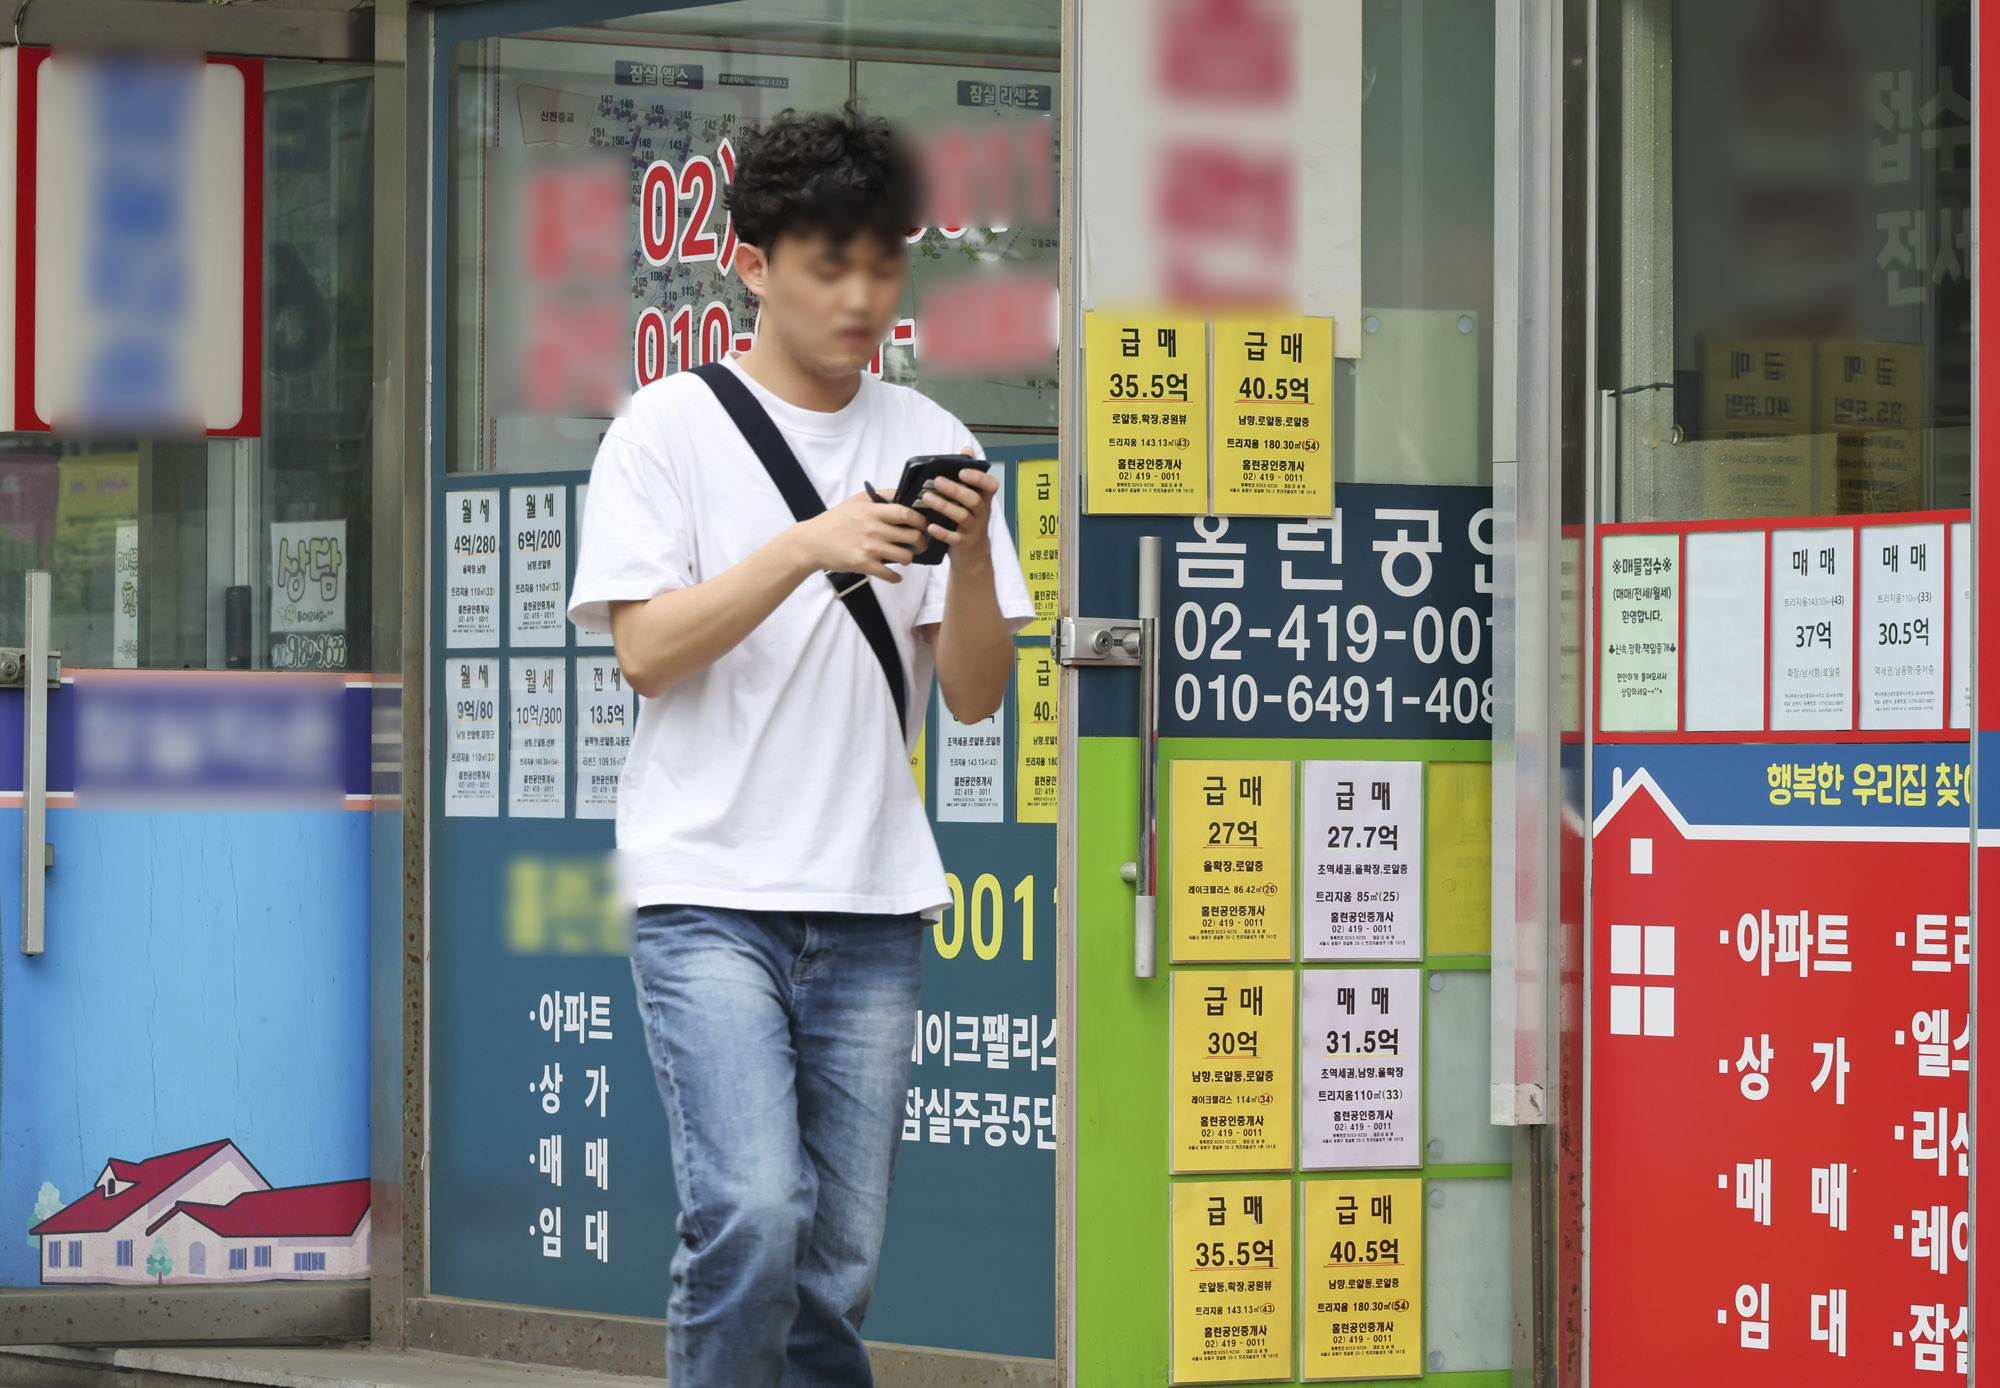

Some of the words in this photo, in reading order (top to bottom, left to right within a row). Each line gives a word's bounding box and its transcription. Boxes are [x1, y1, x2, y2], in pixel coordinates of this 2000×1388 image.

[630, 65, 658, 85] 잠실
[662, 66, 689, 86] 엘스
[970, 85, 996, 105] 잠실
[1000, 86, 1039, 106] 리센츠
[652, 105, 665, 115] 145
[724, 114, 736, 124] 141
[704, 121, 717, 130] 142
[639, 138, 651, 148] 148
[641, 151, 654, 161] 149
[635, 278, 648, 287] 105
[650, 271, 663, 281] 108
[664, 292, 677, 301] 110
[1121, 328, 1141, 357] 급
[1158, 329, 1177, 358] 매
[1245, 332, 1267, 361] 급
[1281, 333, 1302, 363] 매
[1110, 373, 1188, 401] 35.5억
[1239, 376, 1309, 403] 40.5억
[1109, 437, 1137, 448] 트리지움
[1227, 438, 1260, 449] 트리지움
[1118, 459, 1182, 470] 홈런공인중개사
[1242, 459, 1305, 472] 홈런공인중개사
[1036, 473, 1051, 500] 급
[462, 499, 472, 523] 월
[480, 499, 490, 523] 세
[526, 494, 536, 519] 월
[544, 493, 554, 517] 세
[454, 534, 496, 556] 4억/280
[518, 529, 561, 552] 6억/200
[278, 536, 342, 603] 상담
[1792, 548, 1809, 577] 매
[1820, 547, 1835, 576] 매
[1882, 544, 1898, 573] 매
[1910, 543, 1926, 572] 매
[1621, 609, 1663, 624] 환영합니다.
[1174, 601, 1493, 664] 02-419-00
[1795, 620, 1832, 650] 37억
[1878, 617, 1929, 646] 30.5억
[460, 664, 471, 689] 월
[478, 664, 489, 689] 세
[525, 669, 536, 694] 월
[543, 669, 554, 694] 세
[593, 667, 603, 692] 전
[1036, 660, 1051, 687] 급
[457, 699, 493, 721] 9억/80
[516, 704, 563, 726] 10억/300
[590, 704, 625, 726] 13.5억
[1203, 776, 1227, 806] 급
[1240, 776, 1262, 806] 매
[1336, 782, 1355, 811] 급
[1371, 782, 1390, 811] 매
[1767, 762, 1844, 806] 행복한
[1852, 763, 1927, 806] 우리집
[1208, 821, 1258, 847] 27억
[1327, 825, 1398, 850] 27.7억
[1316, 891, 1352, 903] 트리지움
[1201, 905, 1265, 917] 홈런공인중개사
[1331, 911, 1394, 923] 홈런공인중개사
[1204, 986, 1227, 1016] 급
[1240, 986, 1263, 1016] 매
[1337, 987, 1355, 1015] 매
[1371, 987, 1389, 1015] 매
[1208, 1031, 1258, 1057] 30억
[1326, 1028, 1399, 1055] 31.5억
[1810, 1037, 1850, 1105] 가
[584, 1065, 609, 1118] 가
[1200, 1115, 1264, 1127] 홈런공인중개사
[1333, 1110, 1394, 1122] 홈런공인중개사
[585, 1138, 608, 1191] 매
[1335, 1196, 1358, 1225] 급
[1371, 1195, 1392, 1225] 매
[1811, 1163, 1848, 1232] 매
[1207, 1197, 1227, 1226] 급
[1243, 1196, 1263, 1225] 매
[585, 1210, 608, 1263] 대
[1195, 1239, 1274, 1267] 35.5억
[1330, 1238, 1399, 1264] 40.5억
[1195, 1305, 1224, 1316] 트리지움
[1317, 1302, 1349, 1313] 트리지움
[1204, 1325, 1268, 1338] 홈런공인중개사
[1332, 1322, 1394, 1335] 홈런공인중개사
[1810, 1289, 1847, 1358] 대
